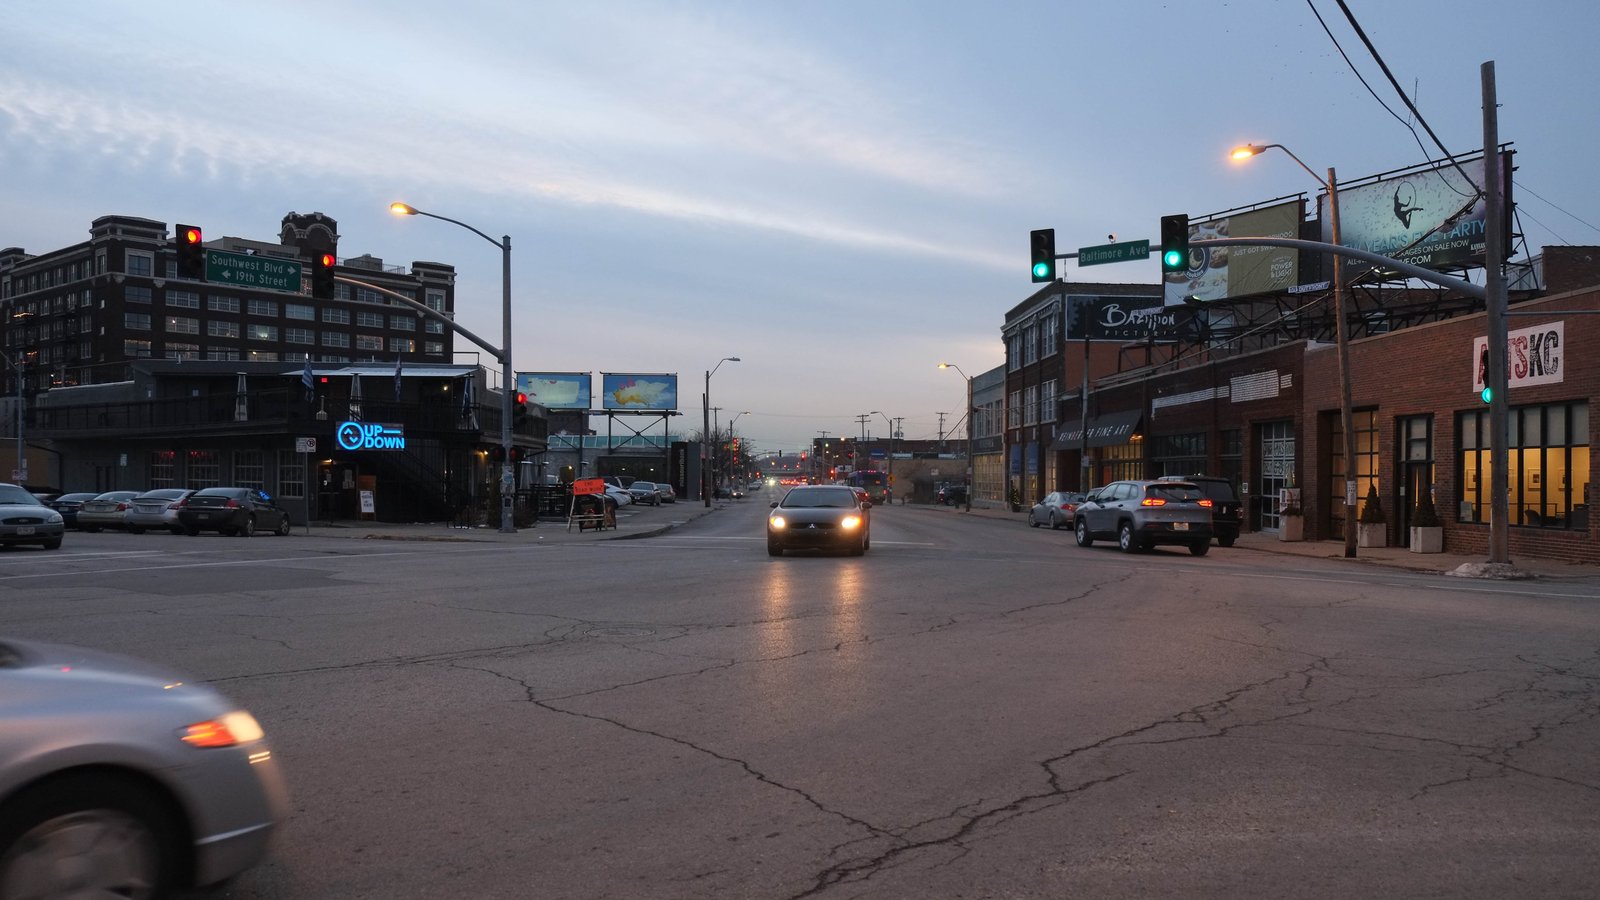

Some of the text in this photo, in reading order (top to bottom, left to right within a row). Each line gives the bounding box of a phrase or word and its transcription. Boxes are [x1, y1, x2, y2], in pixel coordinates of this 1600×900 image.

[1233, 249, 1247, 257] JUST
[1247, 246, 1259, 254] GOT
[1364, 234, 1409, 252] YEAR'S
[1422, 245, 1434, 253] ON
[1434, 241, 1450, 252] SALE
[1451, 239, 1469, 250] NOW
[1081, 245, 1146, 262] Baltimore Ave
[211, 254, 283, 273] Southwest Blvd
[1270, 261, 1293, 271] POWER
[236, 270, 287, 287] 19th Street
[1477, 330, 1560, 385] ATSKC
[365, 436, 405, 449] DOWN
